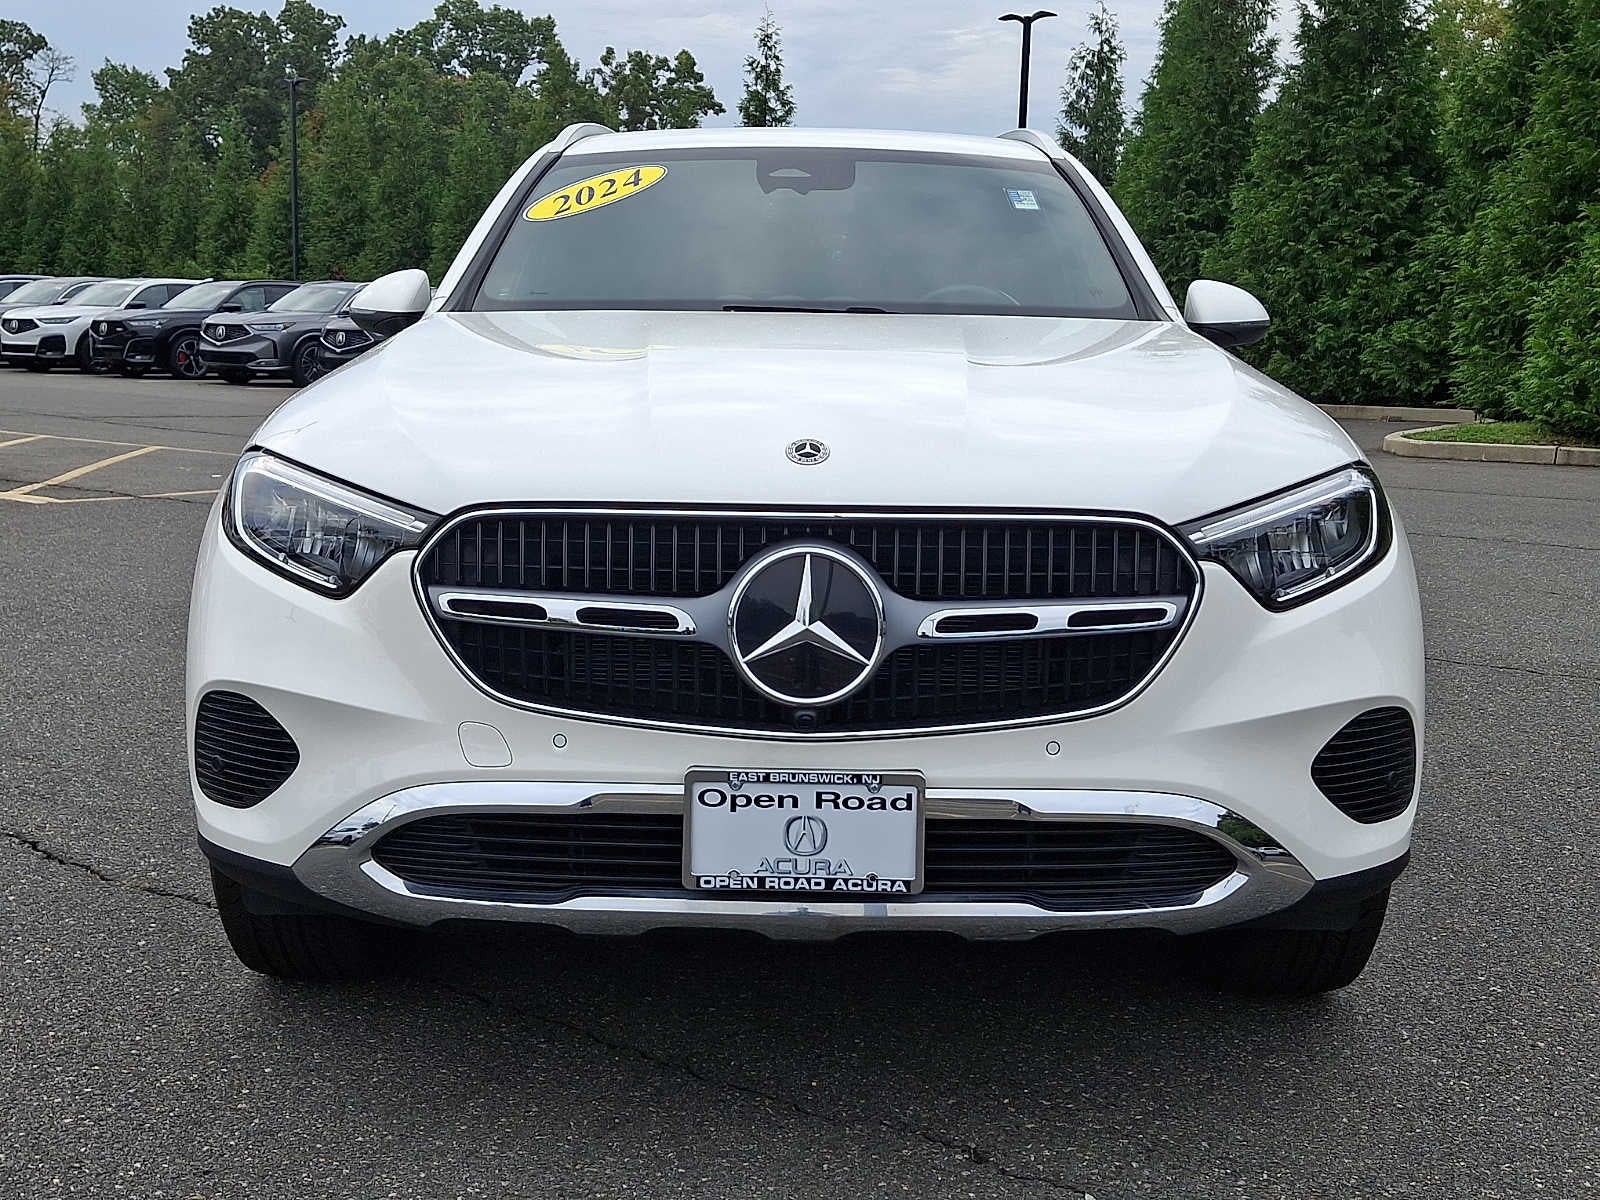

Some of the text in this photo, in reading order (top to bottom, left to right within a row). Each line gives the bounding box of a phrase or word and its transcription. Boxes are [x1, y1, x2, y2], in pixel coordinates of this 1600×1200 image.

[553, 169, 643, 216] 2024
[729, 772, 766, 782] EAST
[861, 774, 881, 784] NJ
[697, 788, 913, 812] Open Road
[753, 857, 853, 876] ACURA
[699, 876, 907, 892] OPEN ROAD ACURA
